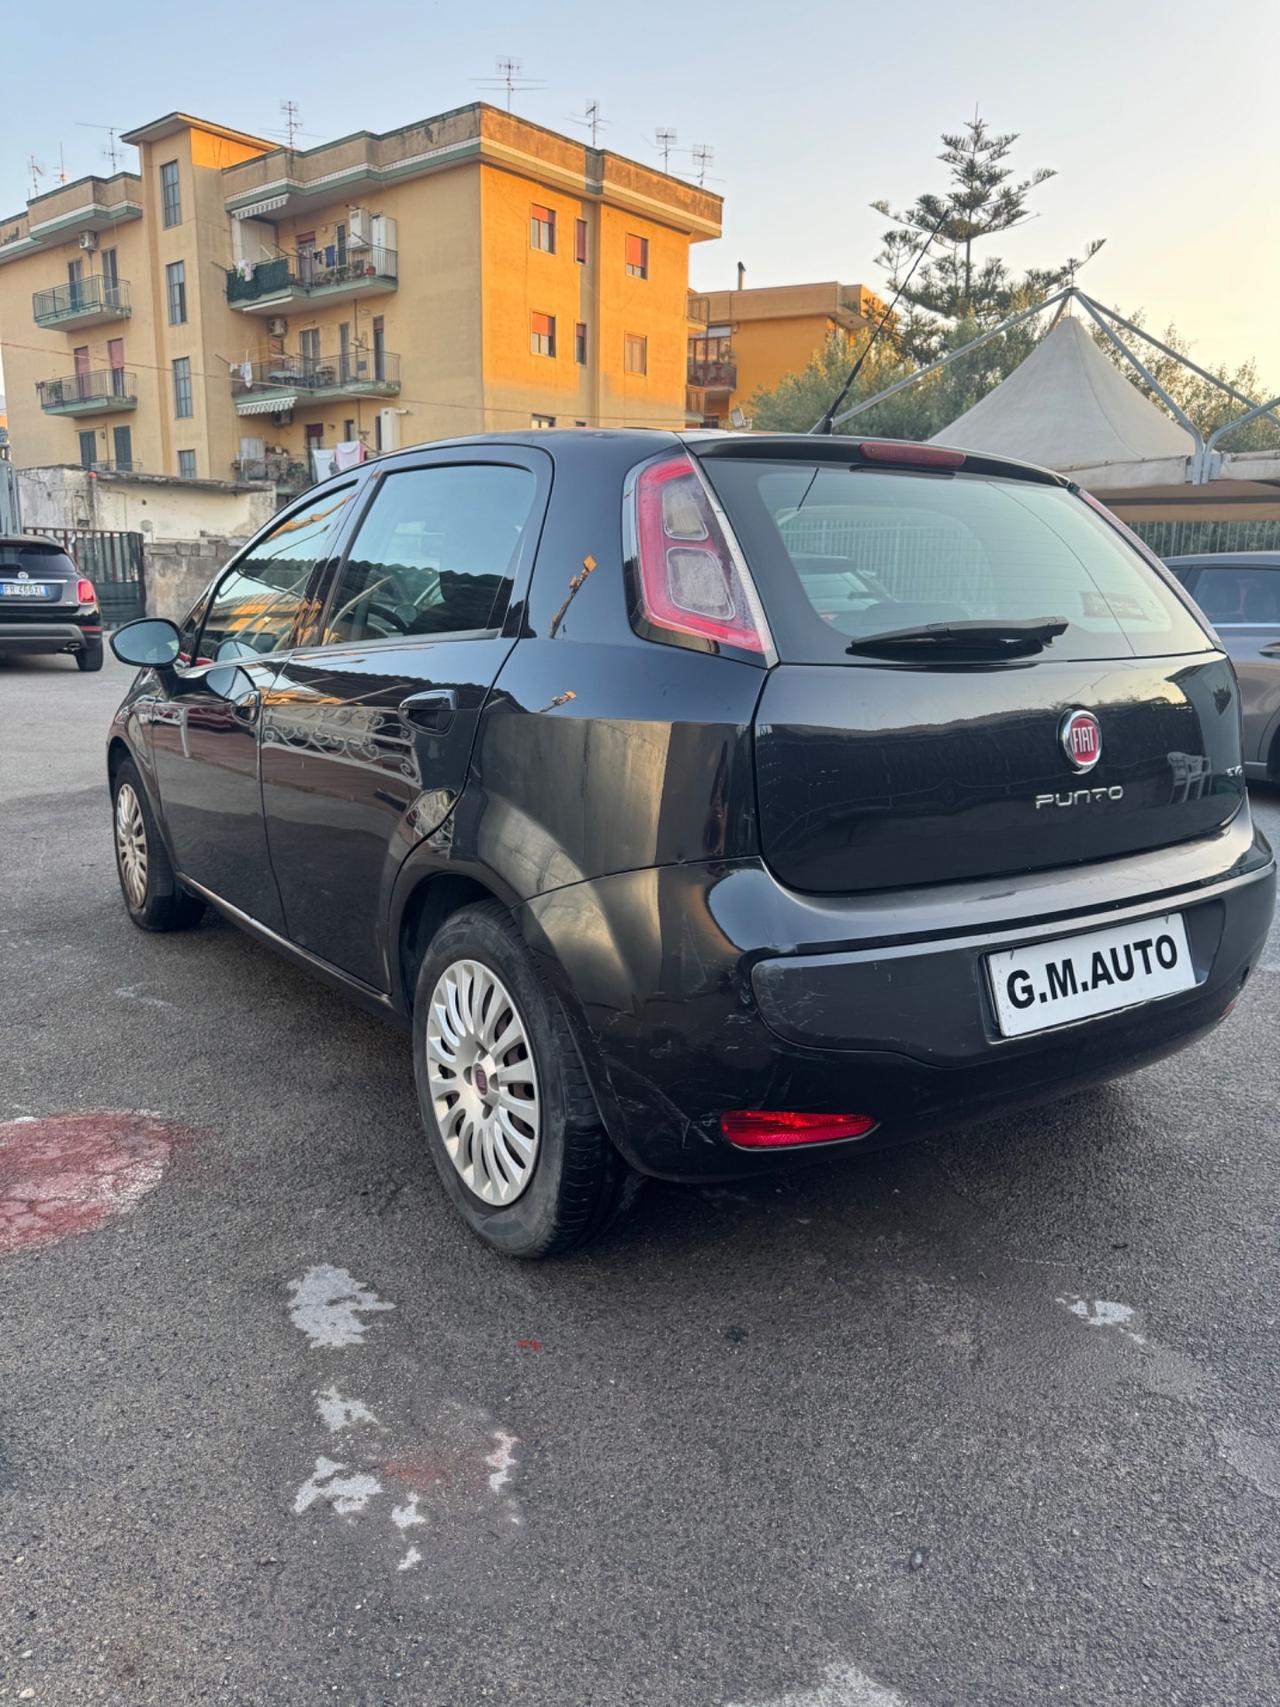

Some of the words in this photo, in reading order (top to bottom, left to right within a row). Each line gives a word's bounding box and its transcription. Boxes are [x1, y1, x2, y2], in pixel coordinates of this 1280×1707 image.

[1072, 726, 1094, 753] FIAT
[1036, 786, 1123, 809] PUNTO
[1006, 934, 1178, 1009] G.M.AUTO
